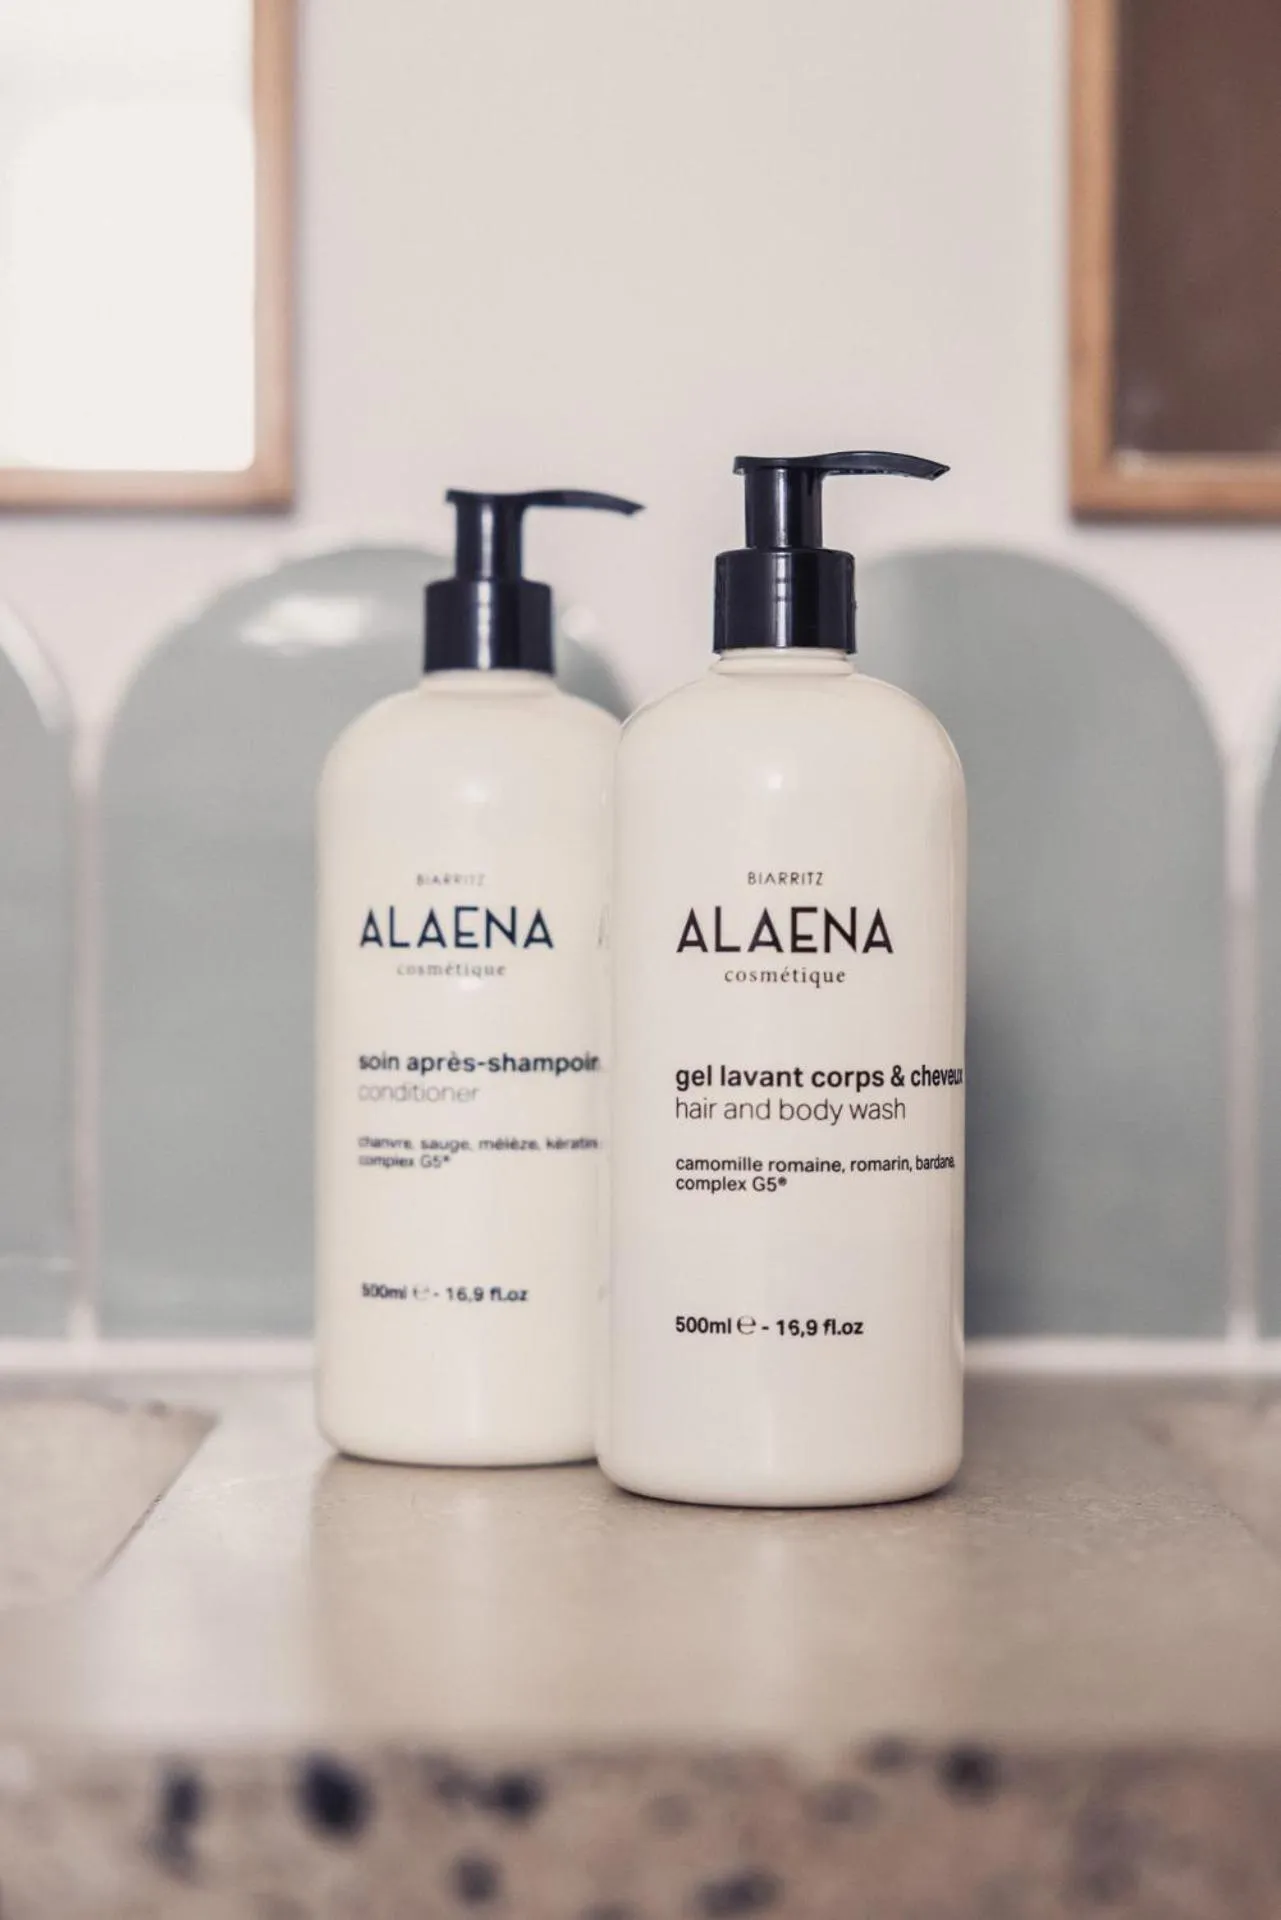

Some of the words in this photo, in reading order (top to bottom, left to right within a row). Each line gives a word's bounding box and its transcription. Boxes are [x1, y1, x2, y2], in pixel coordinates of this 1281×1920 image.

[747, 871, 824, 886] BIARRITZ
[359, 905, 555, 949] ALAENA
[676, 905, 895, 954] ALAENA
[397, 961, 507, 979] cosmétique
[724, 965, 847, 989] cosmétique
[358, 1051, 400, 1072] soin
[675, 1064, 713, 1092] gel
[720, 1064, 804, 1088] lavant
[811, 1069, 886, 1093] corps
[890, 1064, 906, 1088] &
[358, 1082, 479, 1103] conditioner
[675, 1096, 718, 1120] hair
[723, 1097, 771, 1121] and
[779, 1097, 844, 1126] body
[849, 1096, 906, 1120] wash
[358, 1153, 414, 1169] complex
[675, 1156, 763, 1172] camomille
[768, 1156, 846, 1174] romaine,
[850, 1155, 913, 1173] romarin,
[675, 1176, 747, 1194] complex
[361, 1281, 408, 1300] 500ml
[675, 1315, 732, 1335] 500ml
[776, 1318, 819, 1338] 16,9
[822, 1318, 864, 1336] fl.oz
